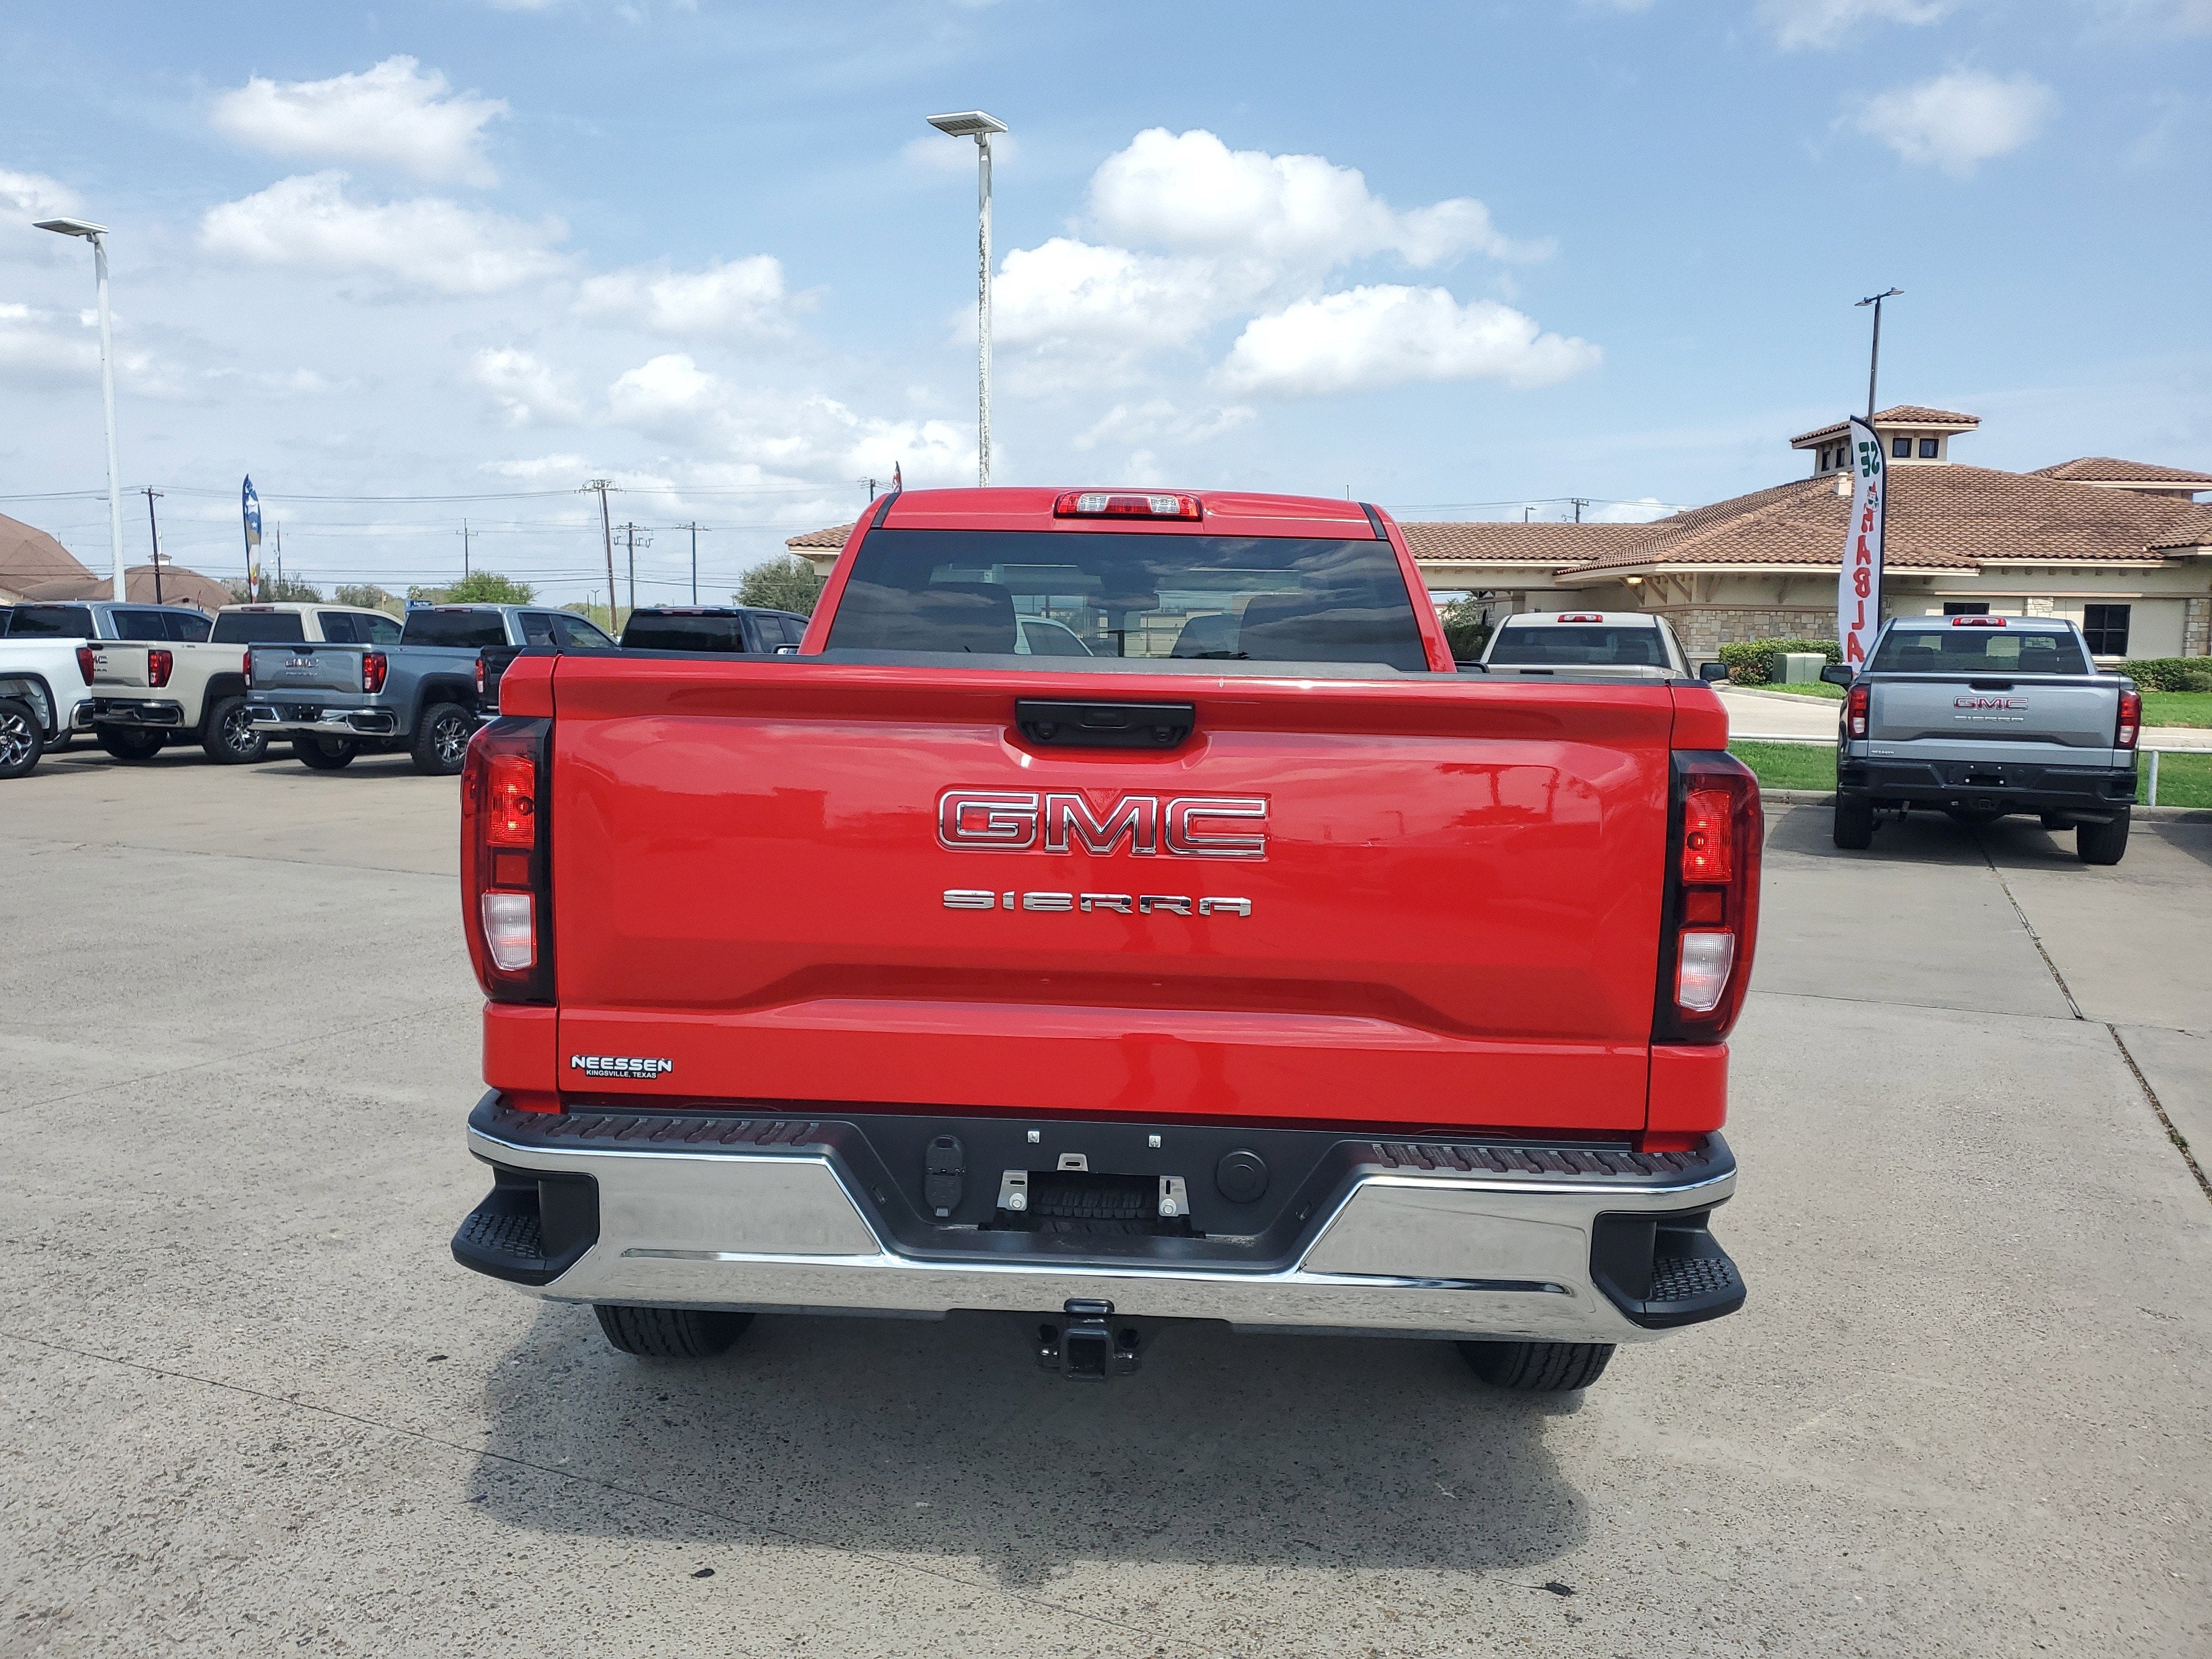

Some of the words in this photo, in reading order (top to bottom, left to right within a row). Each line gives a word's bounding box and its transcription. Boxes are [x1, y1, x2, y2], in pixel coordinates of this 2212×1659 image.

[1954, 696, 2028, 711] GMC
[939, 790, 1267, 856] GMC
[943, 889, 1252, 917] SIERRA
[571, 1055, 673, 1072] NEESSEN
[586, 1069, 631, 1077] KINGSVILLE,
